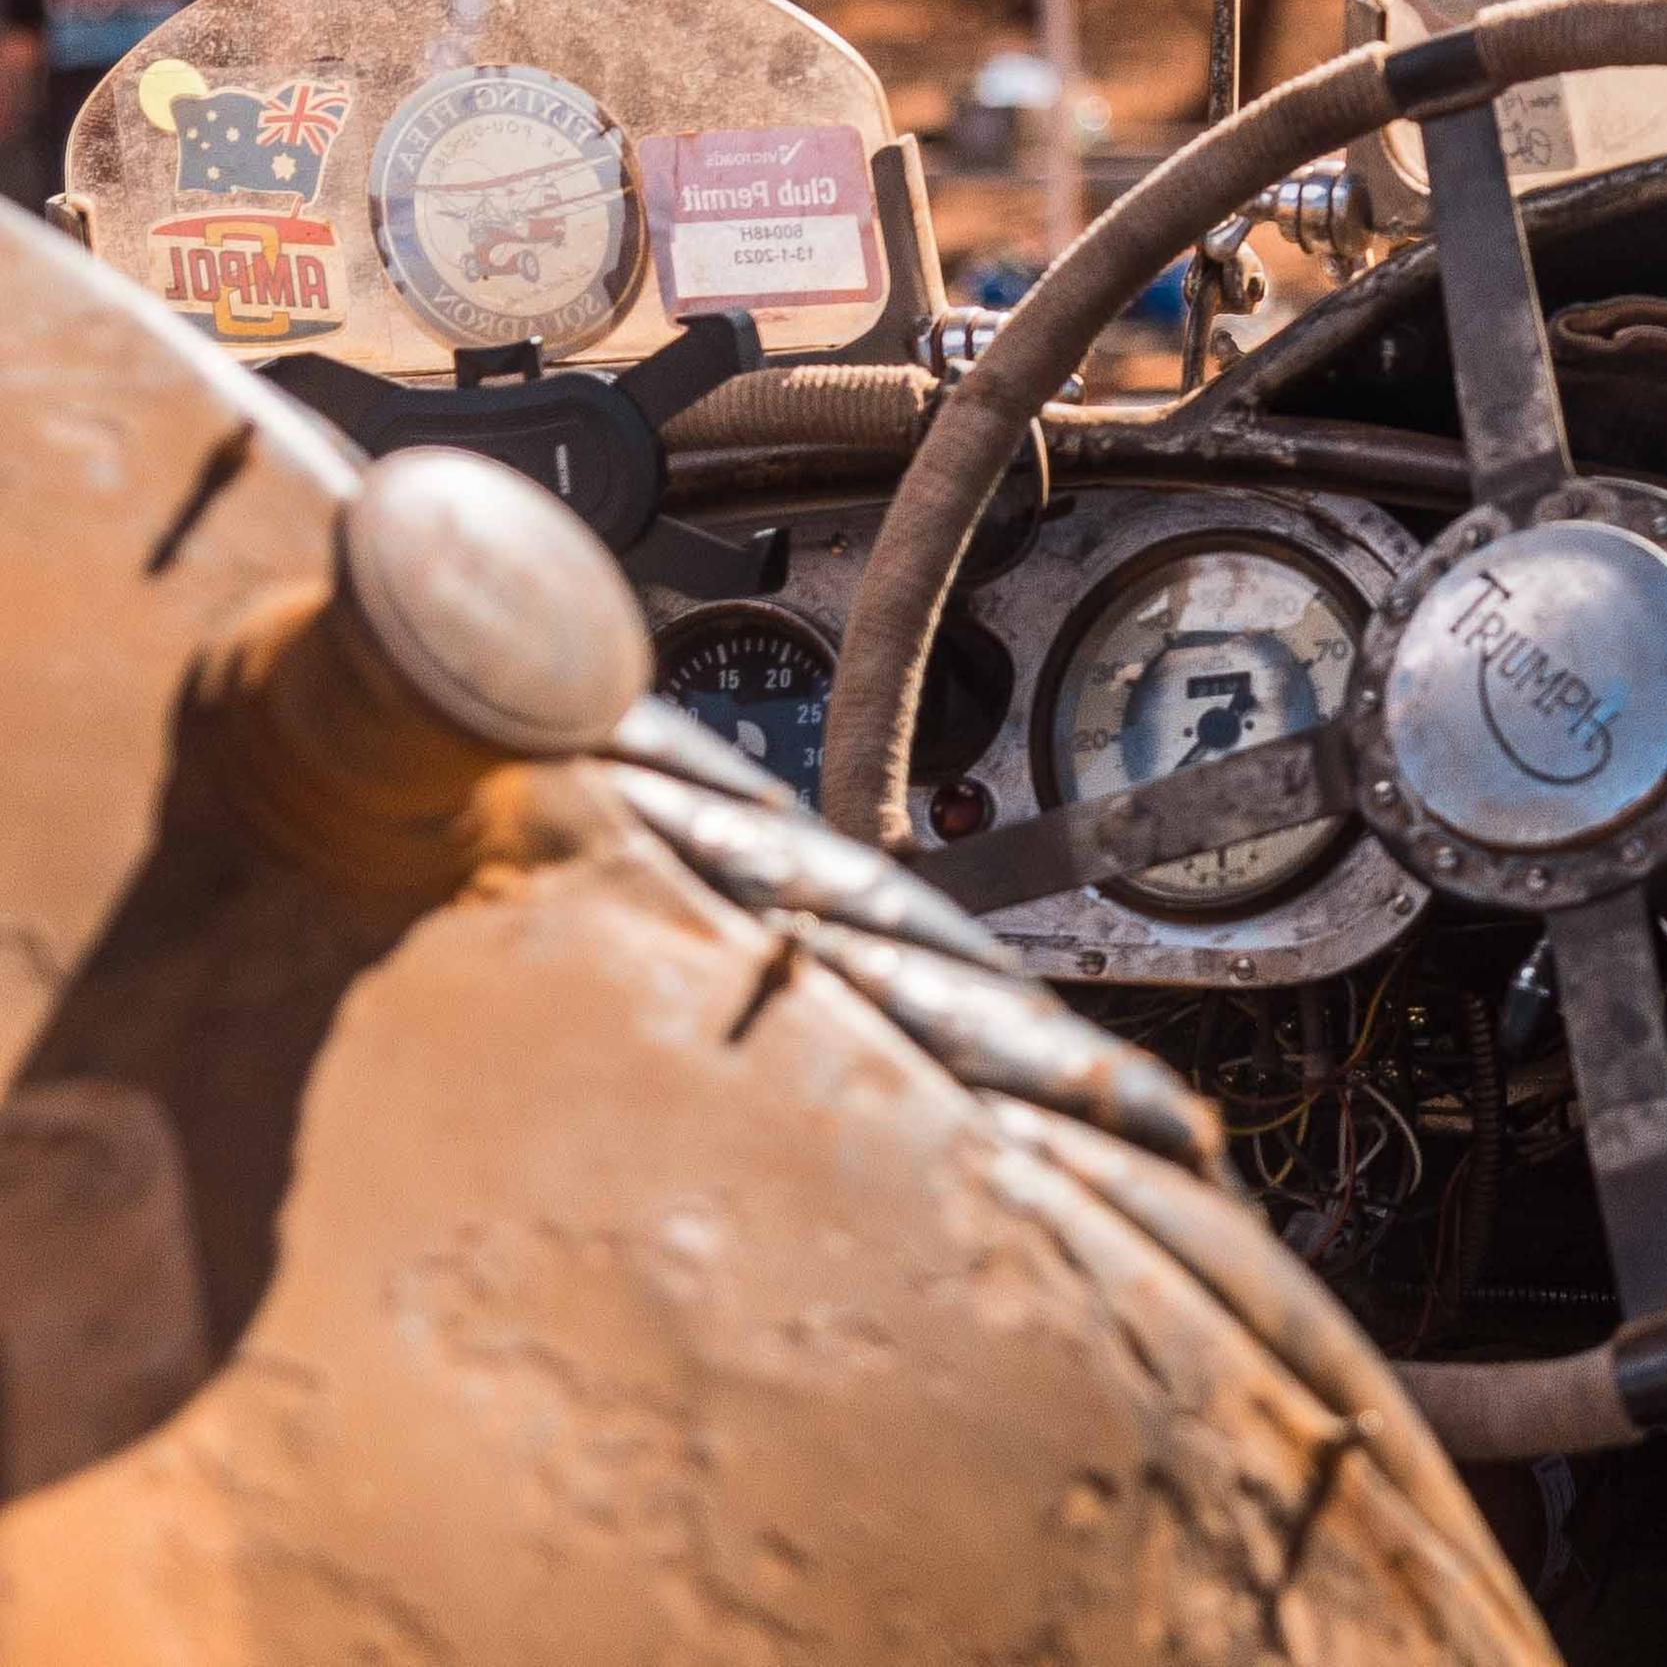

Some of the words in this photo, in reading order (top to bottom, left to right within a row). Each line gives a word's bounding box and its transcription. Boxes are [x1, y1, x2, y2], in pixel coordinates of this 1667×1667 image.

[1313, 637, 1347, 661] 70
[1449, 570, 1620, 756] TRIUMPH
[718, 669, 741, 690] 15
[764, 668, 792, 689] 20
[796, 703, 823, 725] 25
[1077, 730, 1109, 753] 20
